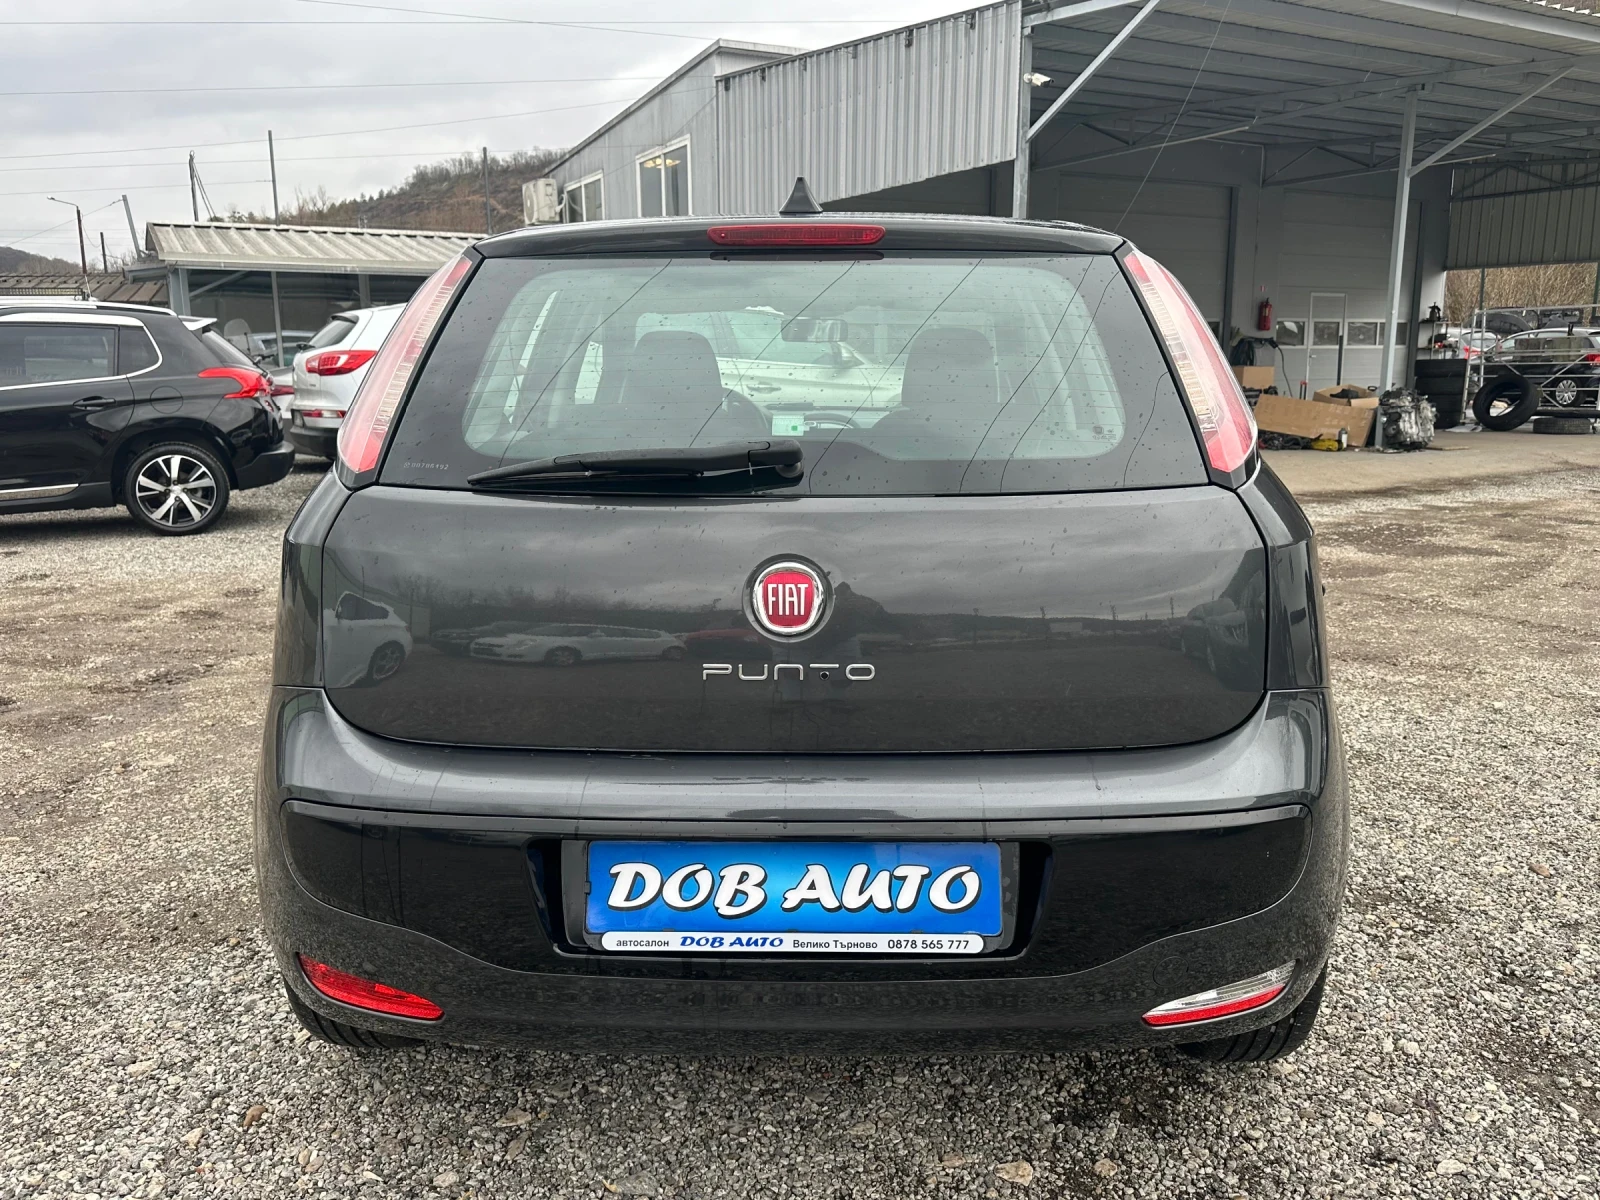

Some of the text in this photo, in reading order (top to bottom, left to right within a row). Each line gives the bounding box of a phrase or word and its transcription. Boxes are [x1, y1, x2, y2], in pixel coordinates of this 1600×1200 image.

[767, 583, 809, 616] FIAT
[702, 663, 876, 681] PUNTO
[607, 862, 982, 918] DOB AUTO
[616, 936, 970, 951] автосалон DOB AUTO Велико Търново 0878 565 777
